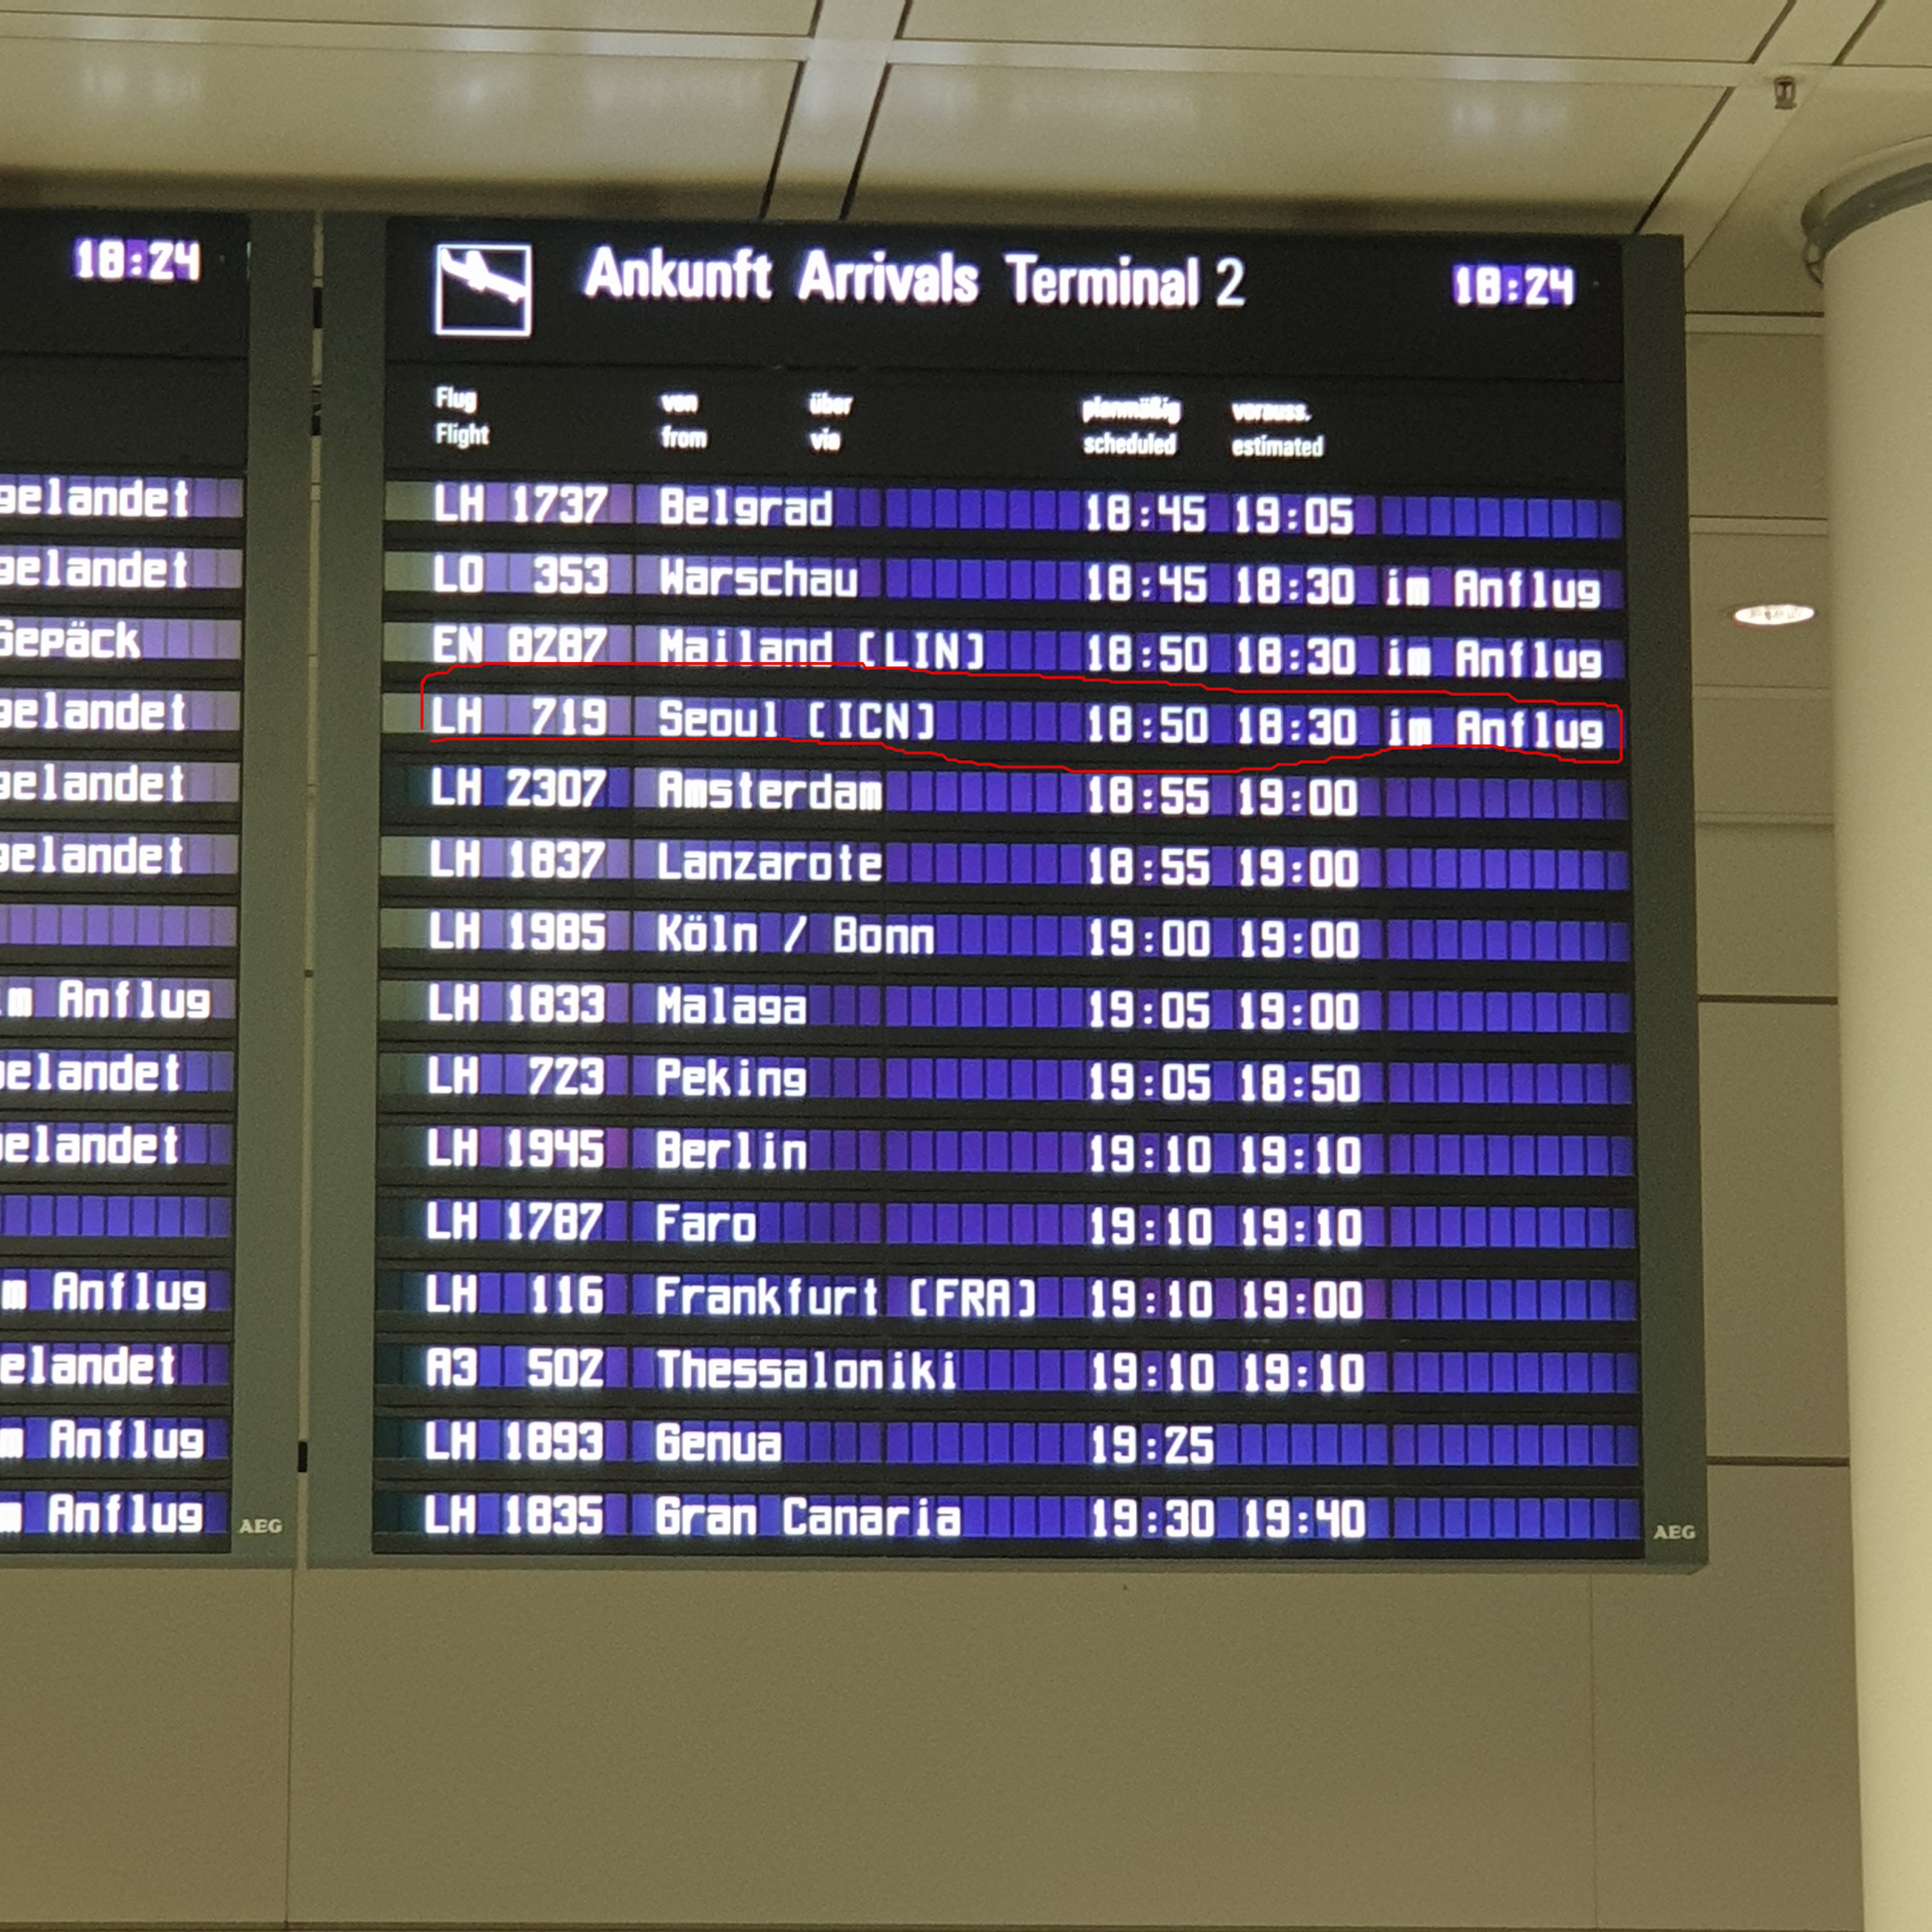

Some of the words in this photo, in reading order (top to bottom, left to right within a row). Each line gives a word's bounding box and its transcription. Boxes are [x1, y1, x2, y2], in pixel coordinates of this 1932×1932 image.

[77, 239, 200, 281] 18:24
[583, 245, 773, 300] Ankunft
[797, 249, 979, 303] Arrivals
[1004, 253, 1199, 307] Terminal
[1216, 257, 1245, 306] 2
[1456, 266, 1574, 306] 18:24
[436, 386, 477, 414] Flug
[661, 394, 699, 413] von
[809, 392, 854, 415] über
[436, 422, 489, 449] Flight
[661, 424, 708, 448] from
[809, 427, 841, 451] via
[1083, 431, 1177, 456] scheduled
[1231, 434, 1324, 457] estimated
[434, 484, 484, 522] LH
[514, 484, 609, 524] 1737
[660, 487, 832, 526] Belgrad
[1087, 494, 1206, 532] 18:45
[1236, 496, 1353, 535] 19:05
[434, 554, 484, 593] LO
[533, 555, 608, 594] 353
[660, 557, 857, 597] Warschau
[1088, 564, 1207, 602] 18:45
[1238, 566, 1354, 605] 18:30
[1386, 569, 1430, 606] im
[1455, 569, 1600, 609] Anflug
[433, 624, 483, 664] EN
[507, 625, 608, 663] 8287
[659, 628, 832, 668] Mailand
[1089, 634, 1208, 673] 18:50
[1238, 636, 1356, 675] 18:30
[1388, 639, 1431, 677] im
[1456, 640, 1602, 679] Anflug
[432, 696, 482, 735] LH
[532, 697, 607, 736] 719
[659, 699, 778, 738] Seoul
[1089, 705, 1208, 744] 18:50
[1239, 707, 1356, 746] 18:30
[1388, 709, 1432, 747] im
[1457, 710, 1603, 749] Anflug
[432, 767, 482, 806] LH
[507, 768, 607, 808] 2307
[658, 770, 882, 811] Amsterdam
[1089, 776, 1209, 815] 18:55
[1239, 778, 1358, 816] 19:00
[430, 839, 480, 878] LH
[510, 839, 606, 879] 1837
[658, 841, 882, 882] Lanzarote
[1090, 847, 1210, 886] 18:55
[1240, 848, 1359, 888] 19:00
[429, 910, 480, 950] LH
[510, 911, 606, 951] 1985
[658, 913, 756, 953] Köln
[834, 916, 933, 954] Bonn
[1090, 918, 1210, 957] 19:00
[1241, 920, 1360, 959] 19:00
[0, 987, 33, 1018] m
[58, 979, 210, 1019] Anflug
[429, 983, 479, 1022] LH
[509, 983, 605, 1023] 1833
[657, 986, 806, 1025] Malaga
[1090, 990, 1210, 1029] 19:05
[1241, 992, 1359, 1031] 19:00
[0, 1052, 180, 1092] elandet
[428, 1055, 479, 1094] LH
[529, 1056, 604, 1096] 723
[657, 1057, 806, 1097] Peking
[1090, 1062, 1211, 1101] 19:05
[1241, 1064, 1360, 1103] 18:50
[0, 1124, 178, 1165] elandet
[428, 1128, 478, 1167] LH
[508, 1128, 604, 1169] 1945
[656, 1130, 806, 1170] Berlin
[1091, 1134, 1211, 1174] 19:10
[1242, 1135, 1361, 1175] 19:10
[427, 1201, 477, 1240] LH
[508, 1201, 604, 1241] 1787
[657, 1203, 756, 1242] Faro
[1091, 1206, 1212, 1246] 19:10
[1243, 1208, 1362, 1247] 19:10
[53, 1271, 206, 1311] Anflug
[427, 1274, 477, 1313] LH
[533, 1275, 603, 1314] 116
[657, 1276, 877, 1316] Frankfurt
[1092, 1280, 1213, 1318] 19:10
[1244, 1280, 1363, 1319] 19:00
[427, 1347, 477, 1386] A3
[528, 1347, 604, 1388] 502
[657, 1349, 956, 1390] Thessaloniki
[1093, 1352, 1215, 1392] 19:10
[1245, 1353, 1365, 1393] 19:10
[50, 1419, 204, 1459] Anflug
[425, 1421, 476, 1460] LH
[507, 1421, 603, 1461] 1893
[656, 1422, 780, 1462] Genua
[1092, 1425, 1214, 1464] 19:25
[48, 1493, 203, 1533] Anflug
[238, 1517, 283, 1534] AEG
[425, 1494, 476, 1534] LH
[507, 1494, 603, 1535] 1835
[656, 1496, 755, 1536] Gran
[783, 1496, 961, 1537] Canaria
[1093, 1498, 1215, 1538] 19:30
[1245, 1499, 1365, 1538] 19:40
[1652, 1524, 1696, 1540] AEG
